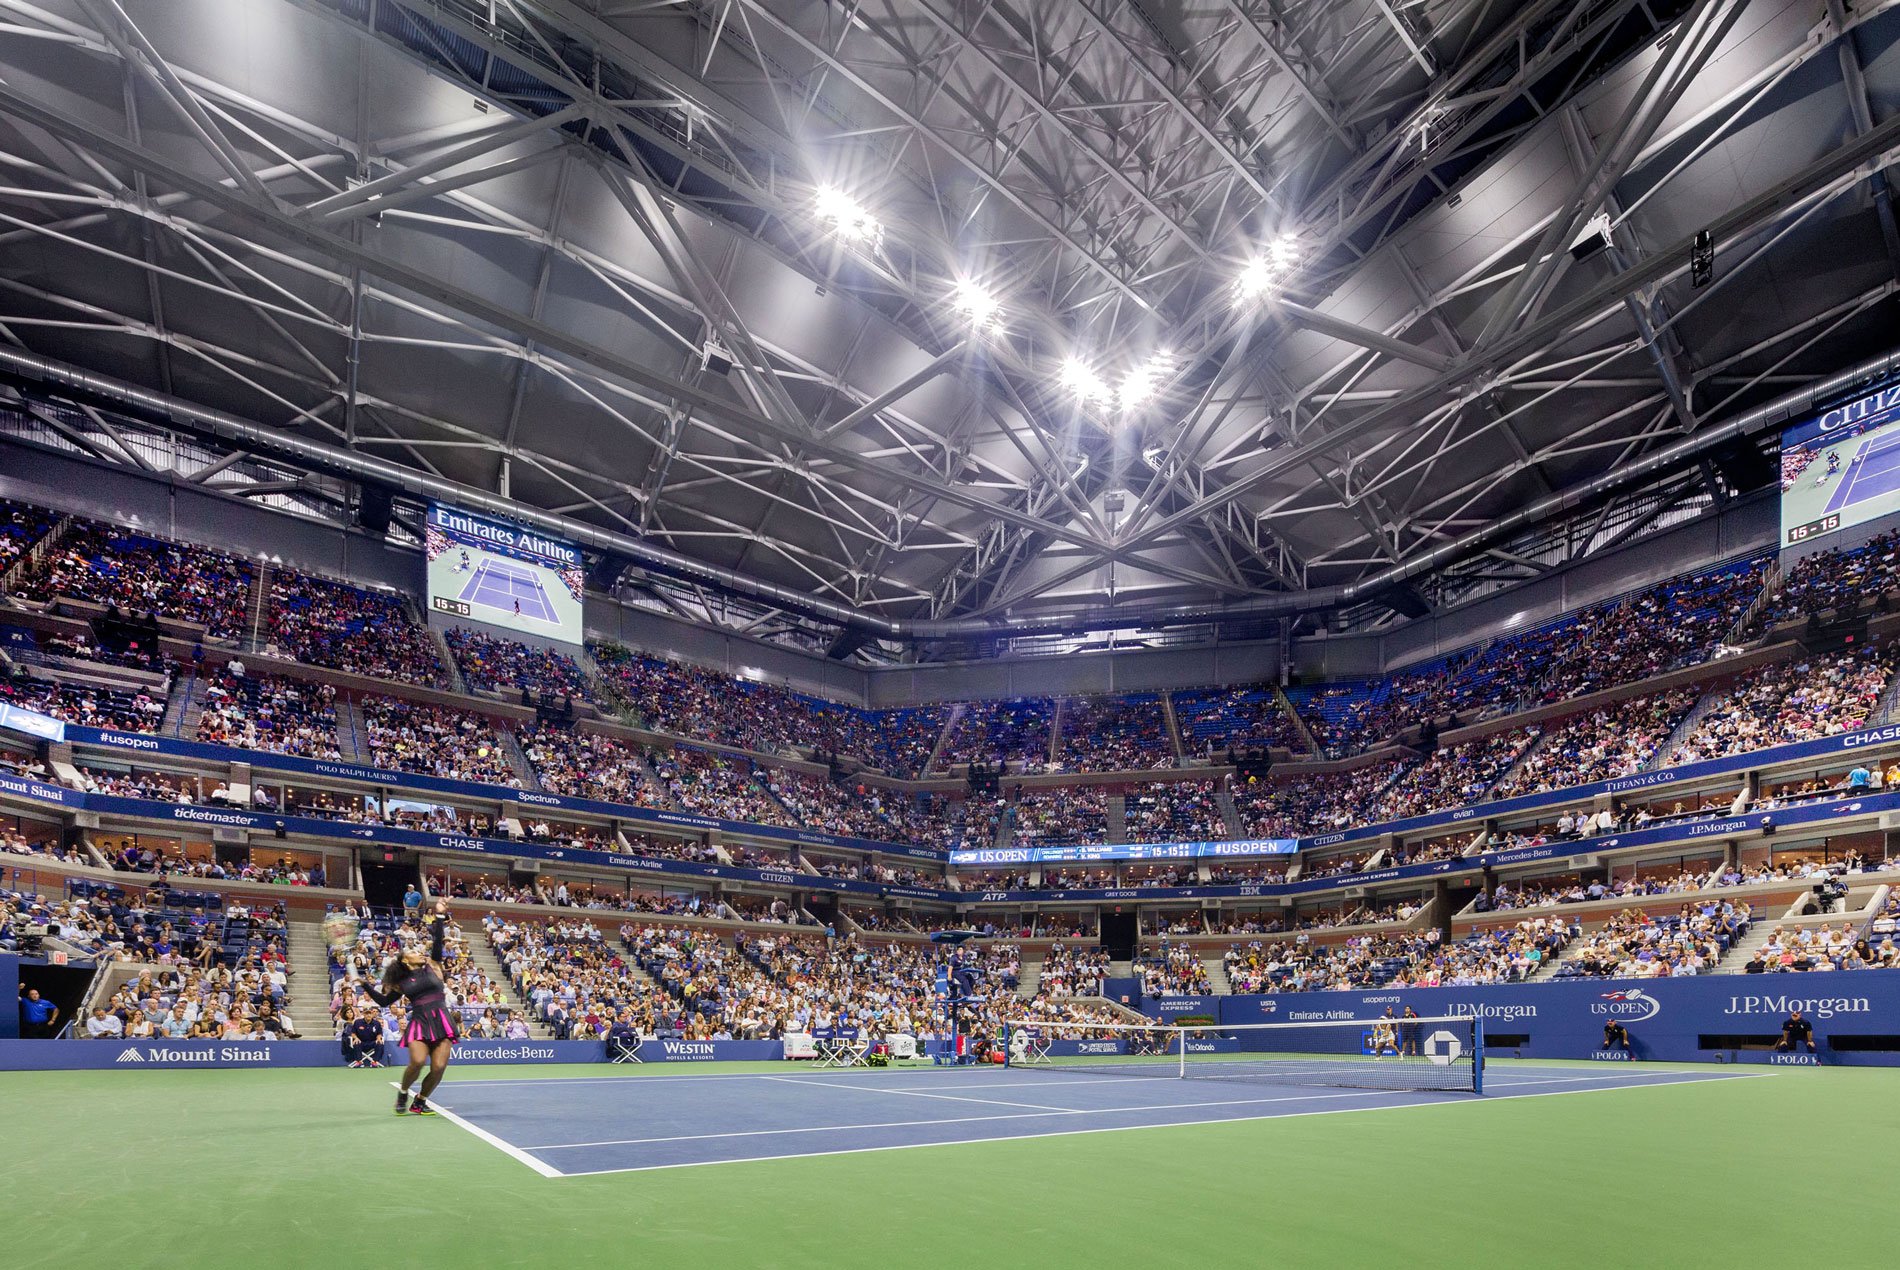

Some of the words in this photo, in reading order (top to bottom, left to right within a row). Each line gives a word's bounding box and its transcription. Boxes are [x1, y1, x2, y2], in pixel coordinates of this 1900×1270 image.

[1791, 526, 1808, 540] 15
[1821, 516, 1838, 531] 15
[436, 508, 514, 544] Emirates
[518, 534, 575, 562] Airline
[435, 598, 448, 610] 15
[456, 604, 469, 615] 15
[100, 732, 158, 750] #usopen
[1844, 730, 1900, 746] CHASE
[315, 764, 338, 774] POLO
[340, 767, 366, 778] RALPH
[367, 770, 398, 782] LAUREN
[1605, 777, 1648, 792] TIFFANY
[31, 785, 63, 801] Sinai
[518, 792, 557, 805] Spectrum
[174, 808, 253, 825] ticketmaster
[658, 814, 692, 824] AMERICAN
[692, 818, 720, 827] EXPRESS
[1452, 808, 1474, 820] evian
[1689, 820, 1747, 836] J.P.Morgan
[440, 837, 484, 850] CHASE
[798, 832, 835, 844] Mercedes-Benz
[1314, 832, 1345, 846] CITIZEN
[1152, 847, 1162, 856] 15
[1168, 846, 1178, 856] 15
[1216, 842, 1278, 854] #USOPEN
[980, 852, 995, 862] US
[996, 850, 1028, 862] OPEN
[1496, 850, 1552, 863] Mercedes-Benz
[609, 856, 638, 868] Emirates
[640, 860, 662, 870] Airline
[760, 872, 794, 884] CITIZEN
[1337, 875, 1369, 884] AMERICAN
[1370, 871, 1399, 880] EXPRESS
[890, 888, 915, 896] AMERICAN
[982, 893, 1006, 901] ATP
[1240, 886, 1260, 896] IBM
[56, 953, 66, 963] EXIT
[1362, 996, 1400, 1004] usopen.org
[1444, 1004, 1536, 1022] J.P.Morgan
[1591, 1004, 1607, 1014] US
[1610, 1002, 1649, 1014] OPEN
[1724, 996, 1870, 1019] J.P.Morgan
[1289, 1011, 1324, 1020] Emirates
[1326, 1010, 1354, 1020] Airline
[148, 1048, 216, 1062] Mount
[221, 1046, 270, 1062] Sinai
[450, 1047, 554, 1060] Mercedes-Benz
[664, 1042, 713, 1054] WESTIN
[1596, 1052, 1621, 1060] POLO
[1777, 1054, 1808, 1064] POLO
